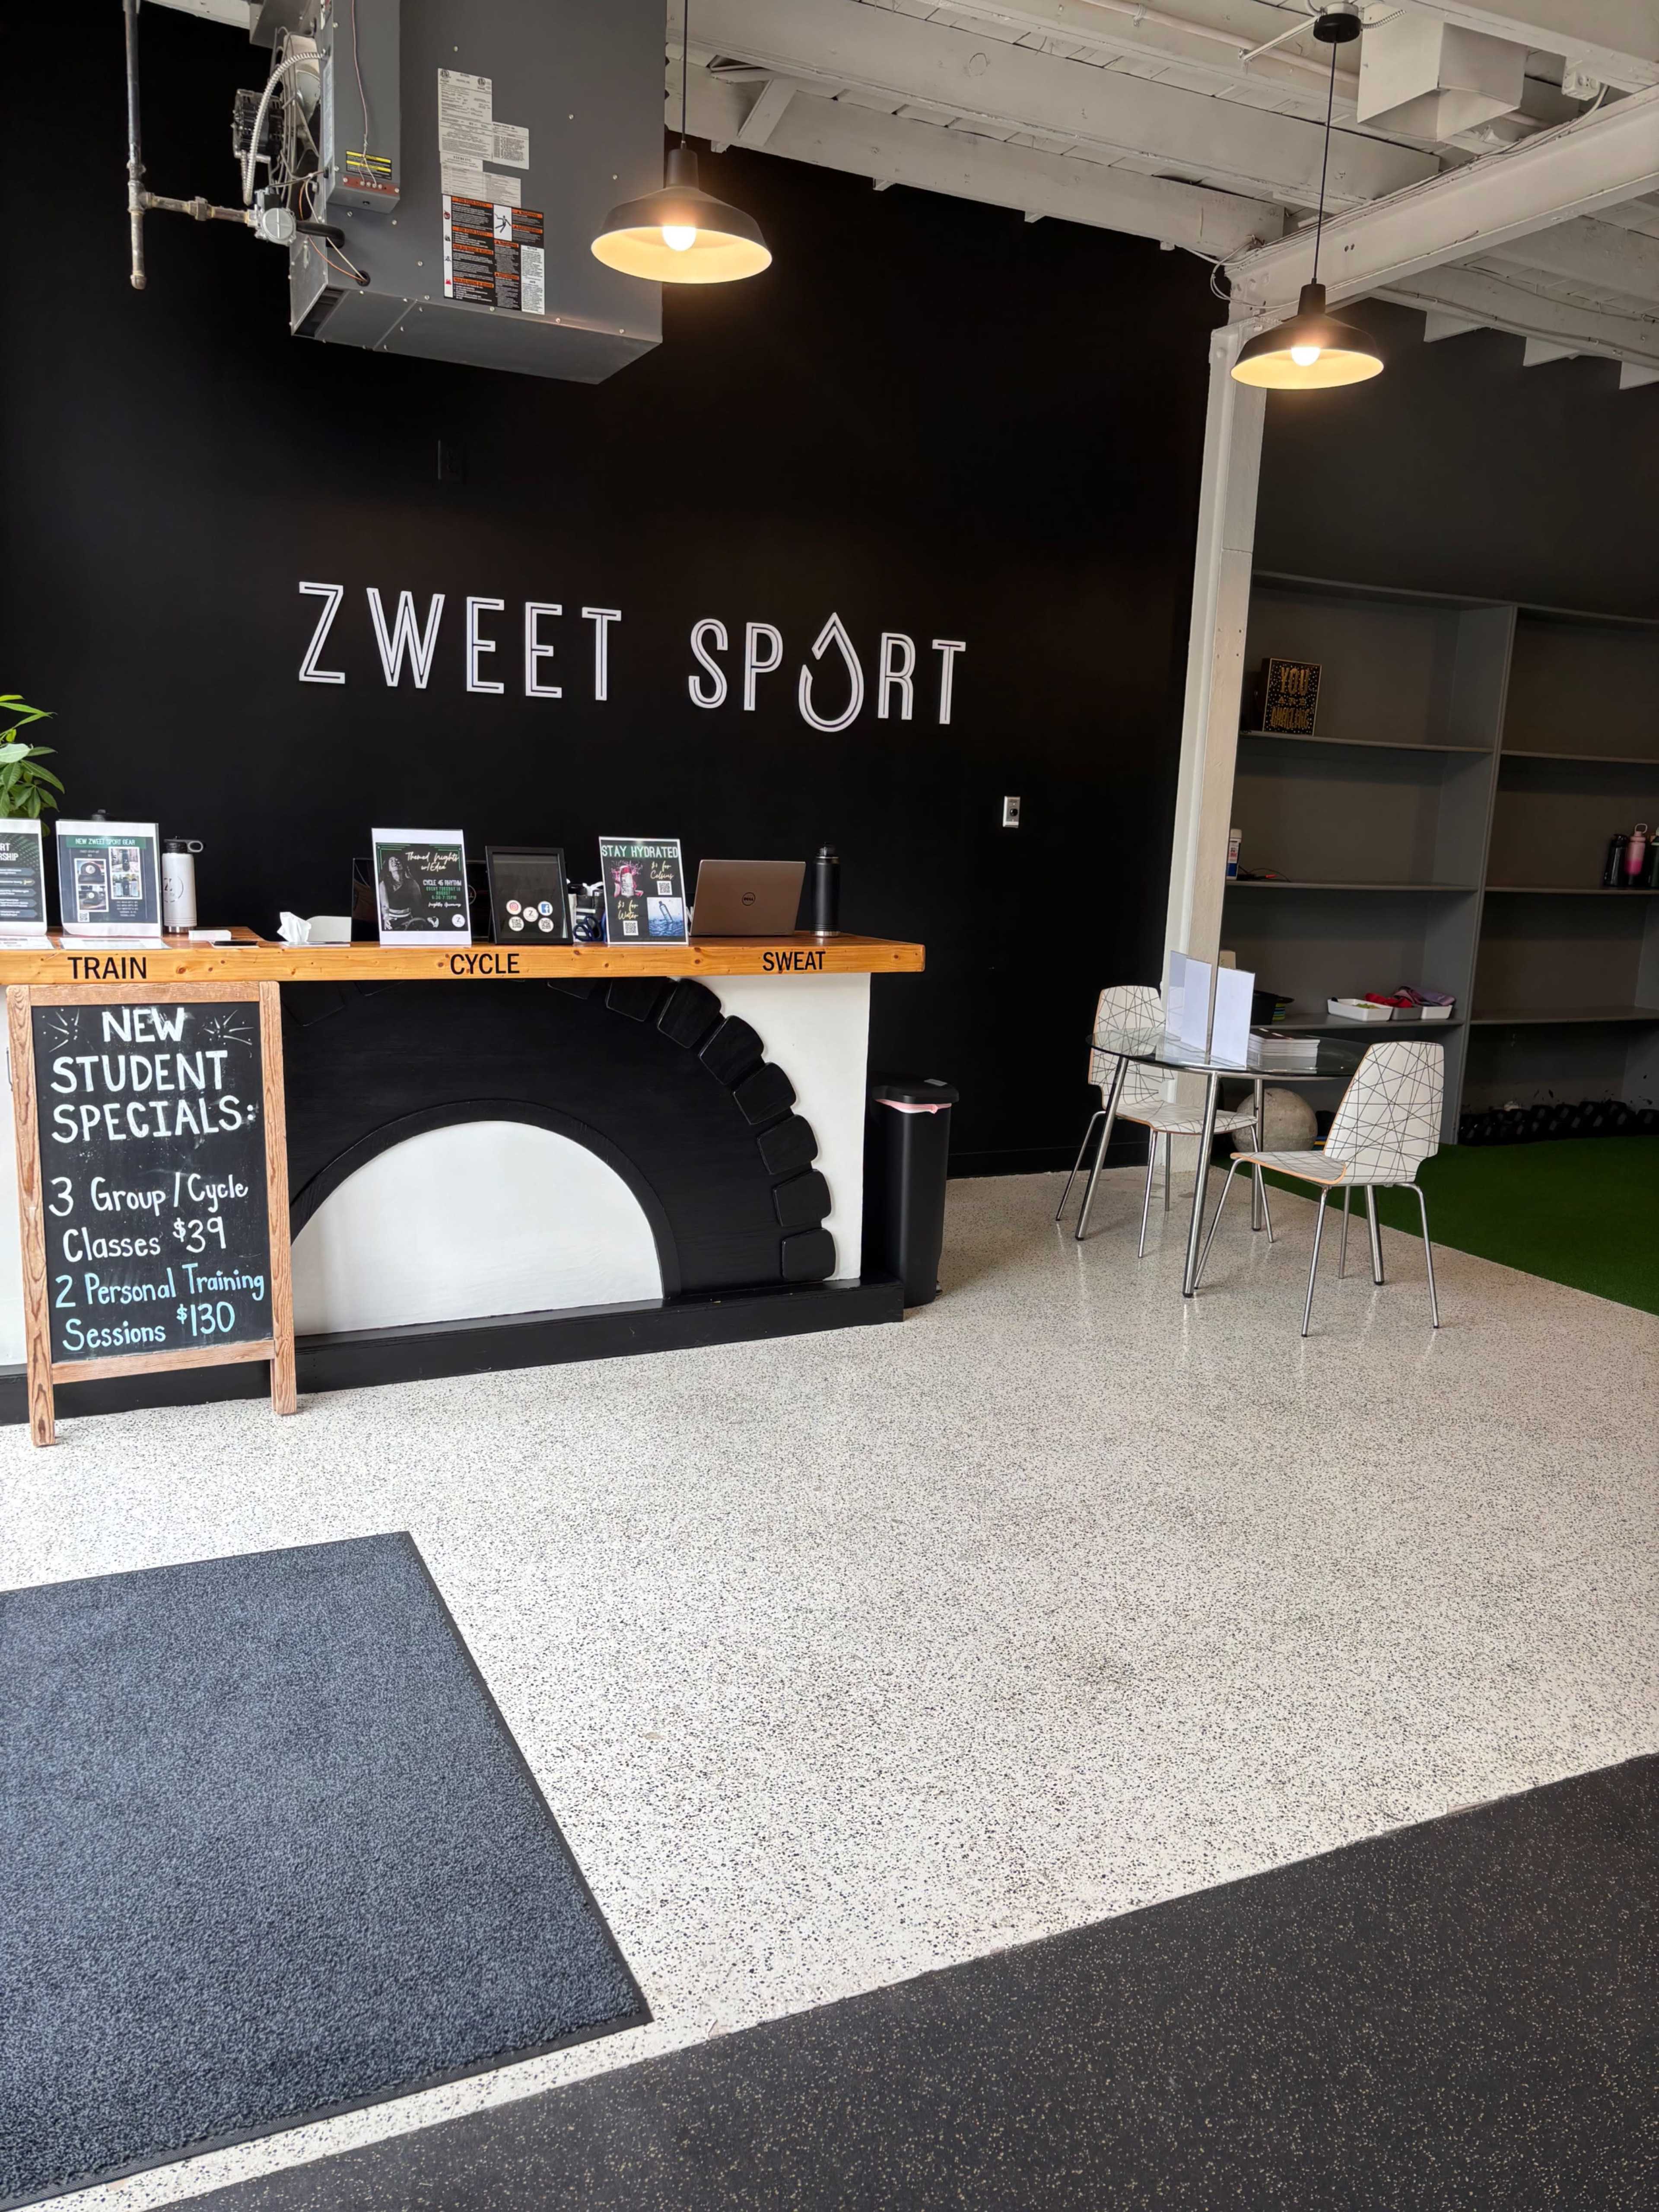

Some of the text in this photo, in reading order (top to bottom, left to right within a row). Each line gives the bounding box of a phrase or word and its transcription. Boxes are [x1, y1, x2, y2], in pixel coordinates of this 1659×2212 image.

[299, 581, 966, 732] ZWEET SPORT
[1281, 667, 1310, 696] YOU
[602, 845, 678, 858] STAY HYDRATED
[67, 957, 146, 979] TRAIN
[451, 953, 520, 974] CYCLE
[763, 952, 826, 971] SWEAT
[102, 1008, 184, 1042] NEW
[51, 1050, 228, 1093] STUDENT
[51, 1095, 254, 1143] SPECIALS:
[49, 1177, 74, 1216] 3
[63, 1216, 226, 1262] Classes $39
[55, 1263, 264, 1308] 2 Personal Training
[63, 1301, 235, 1351] Sessions $130
